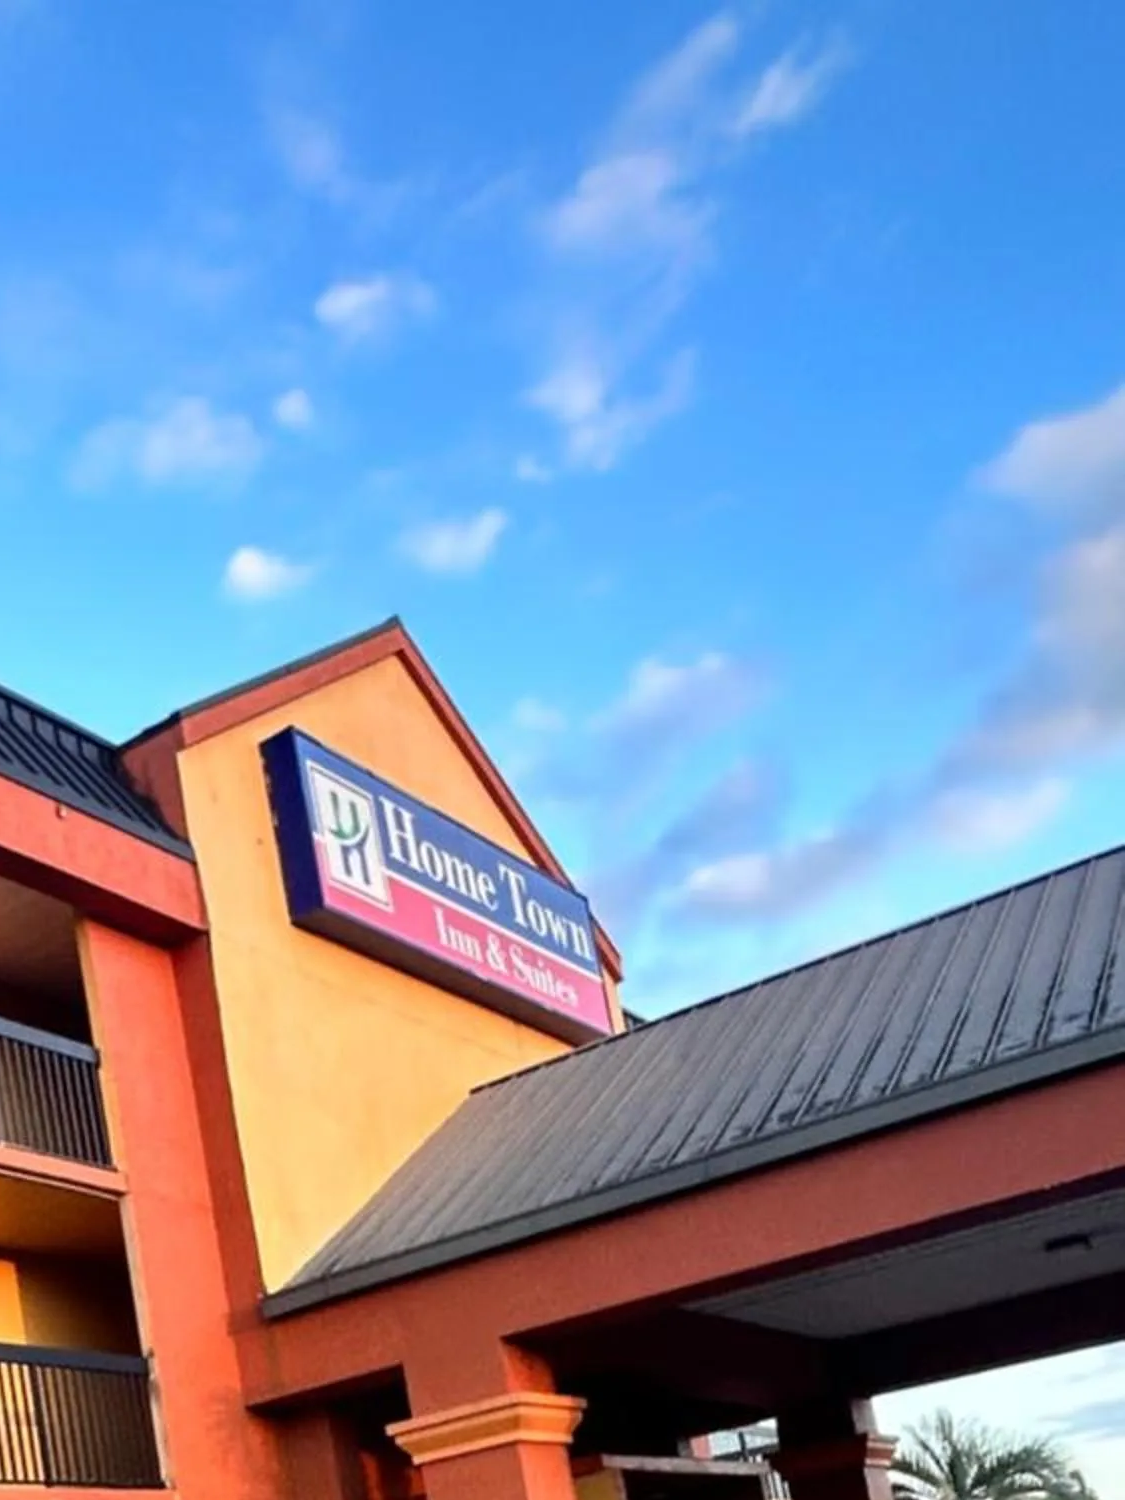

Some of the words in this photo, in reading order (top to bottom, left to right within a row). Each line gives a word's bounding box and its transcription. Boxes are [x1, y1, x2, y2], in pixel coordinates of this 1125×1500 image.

[378, 795, 497, 912] Home
[498, 860, 593, 961] Town
[433, 906, 483, 963] Inn
[486, 931, 508, 976] &
[509, 944, 579, 1007] Suites
